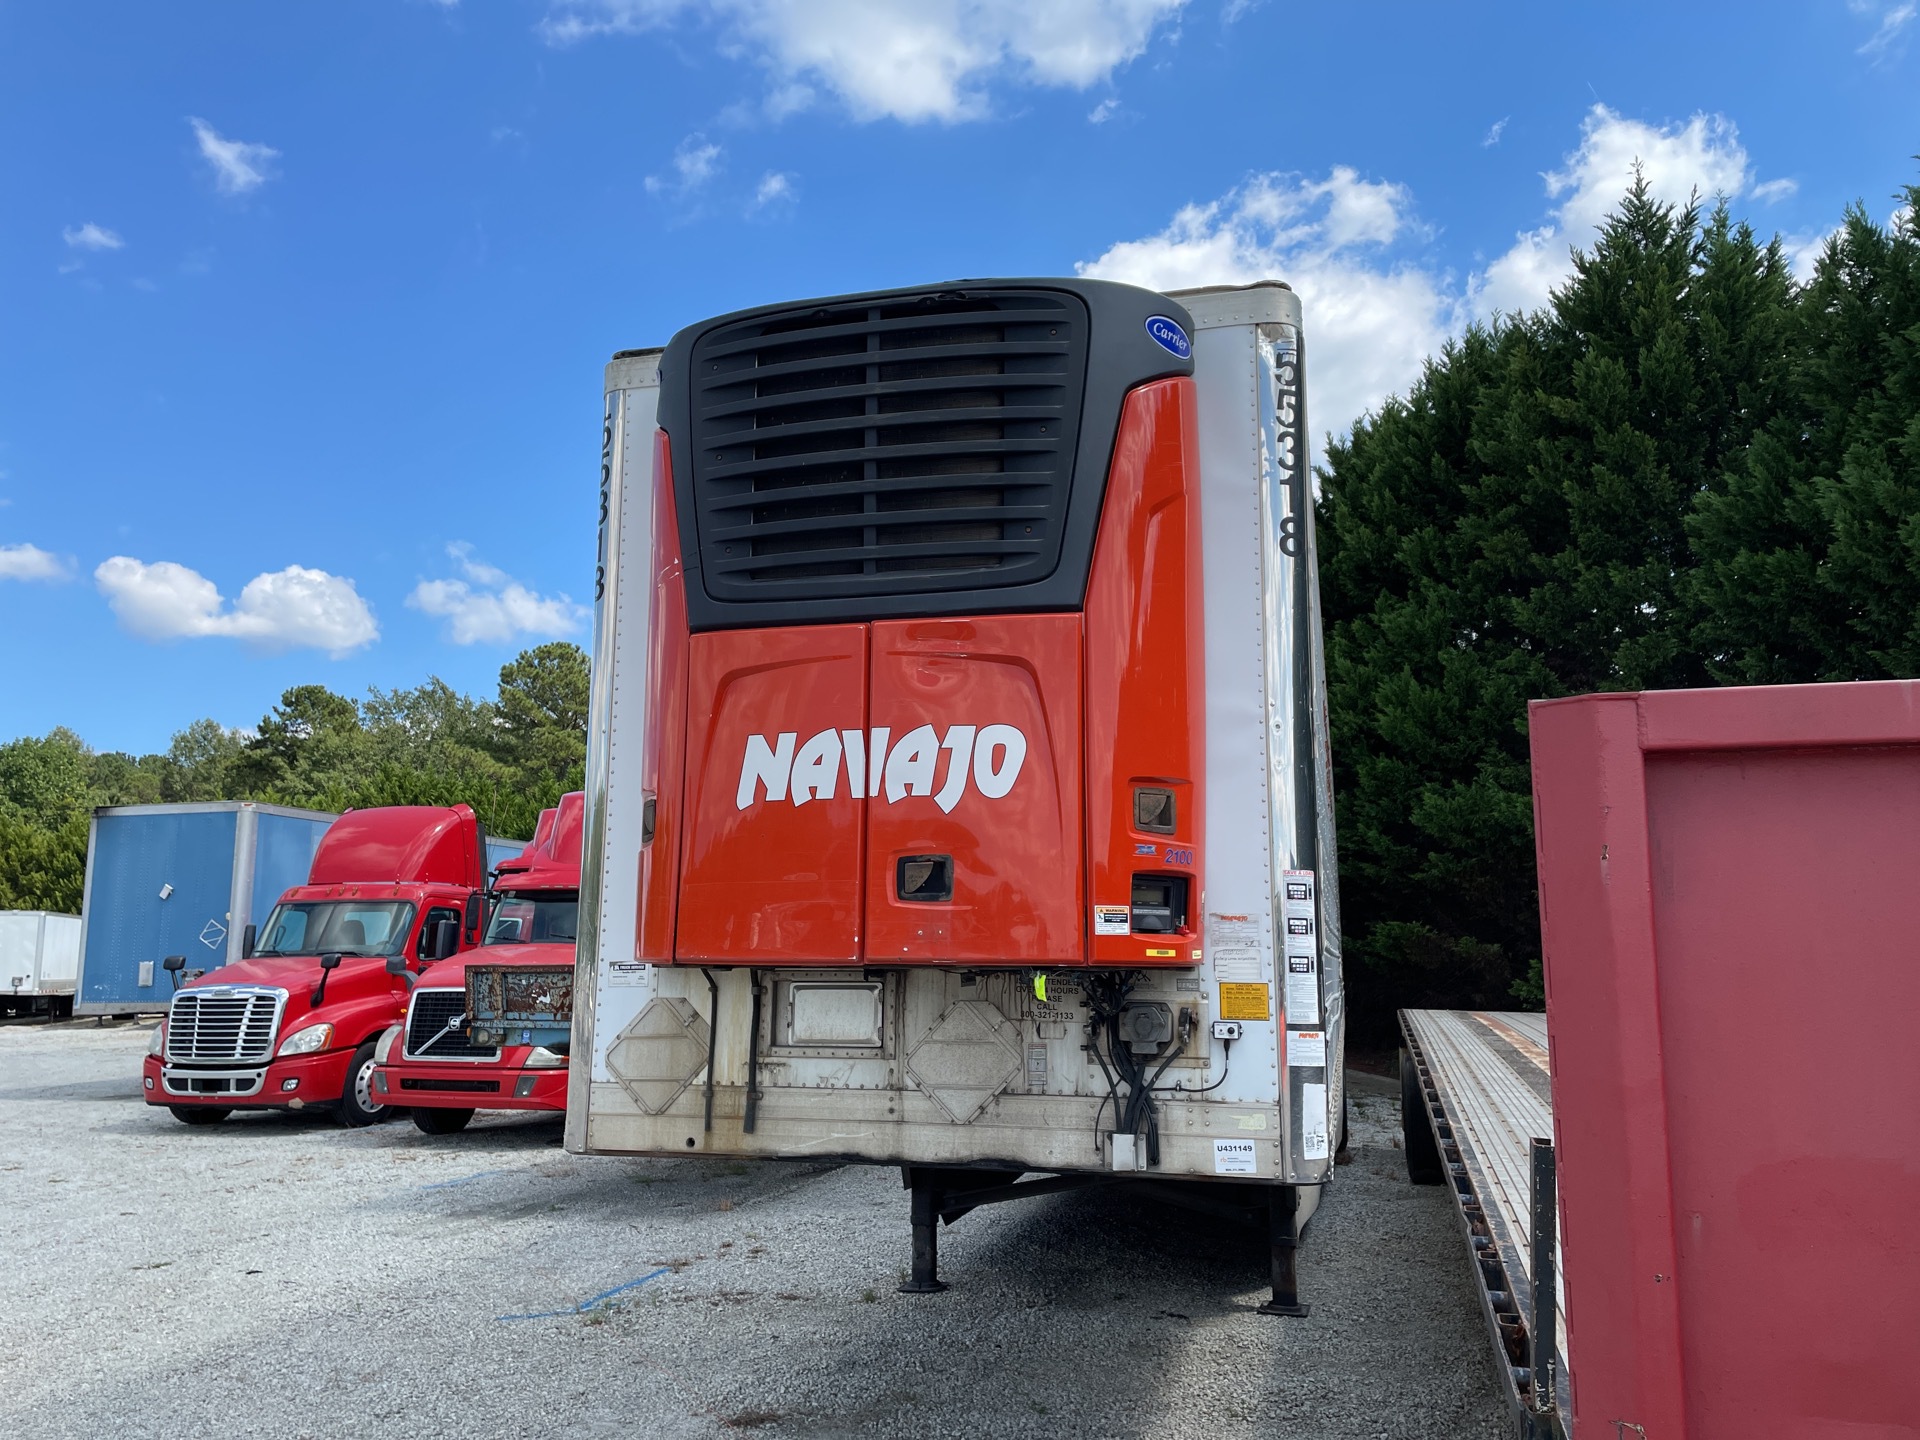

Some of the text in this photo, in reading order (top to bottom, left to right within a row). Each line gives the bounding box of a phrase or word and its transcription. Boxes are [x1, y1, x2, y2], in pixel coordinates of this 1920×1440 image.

[1153, 322, 1187, 351] Carrier
[1275, 348, 1299, 557] 55318
[736, 723, 1027, 815] NAVAJO
[1165, 848, 1193, 865] 2100
[1021, 1011, 1074, 1019] 800-321-1133
[1037, 1003, 1057, 1011] CALL
